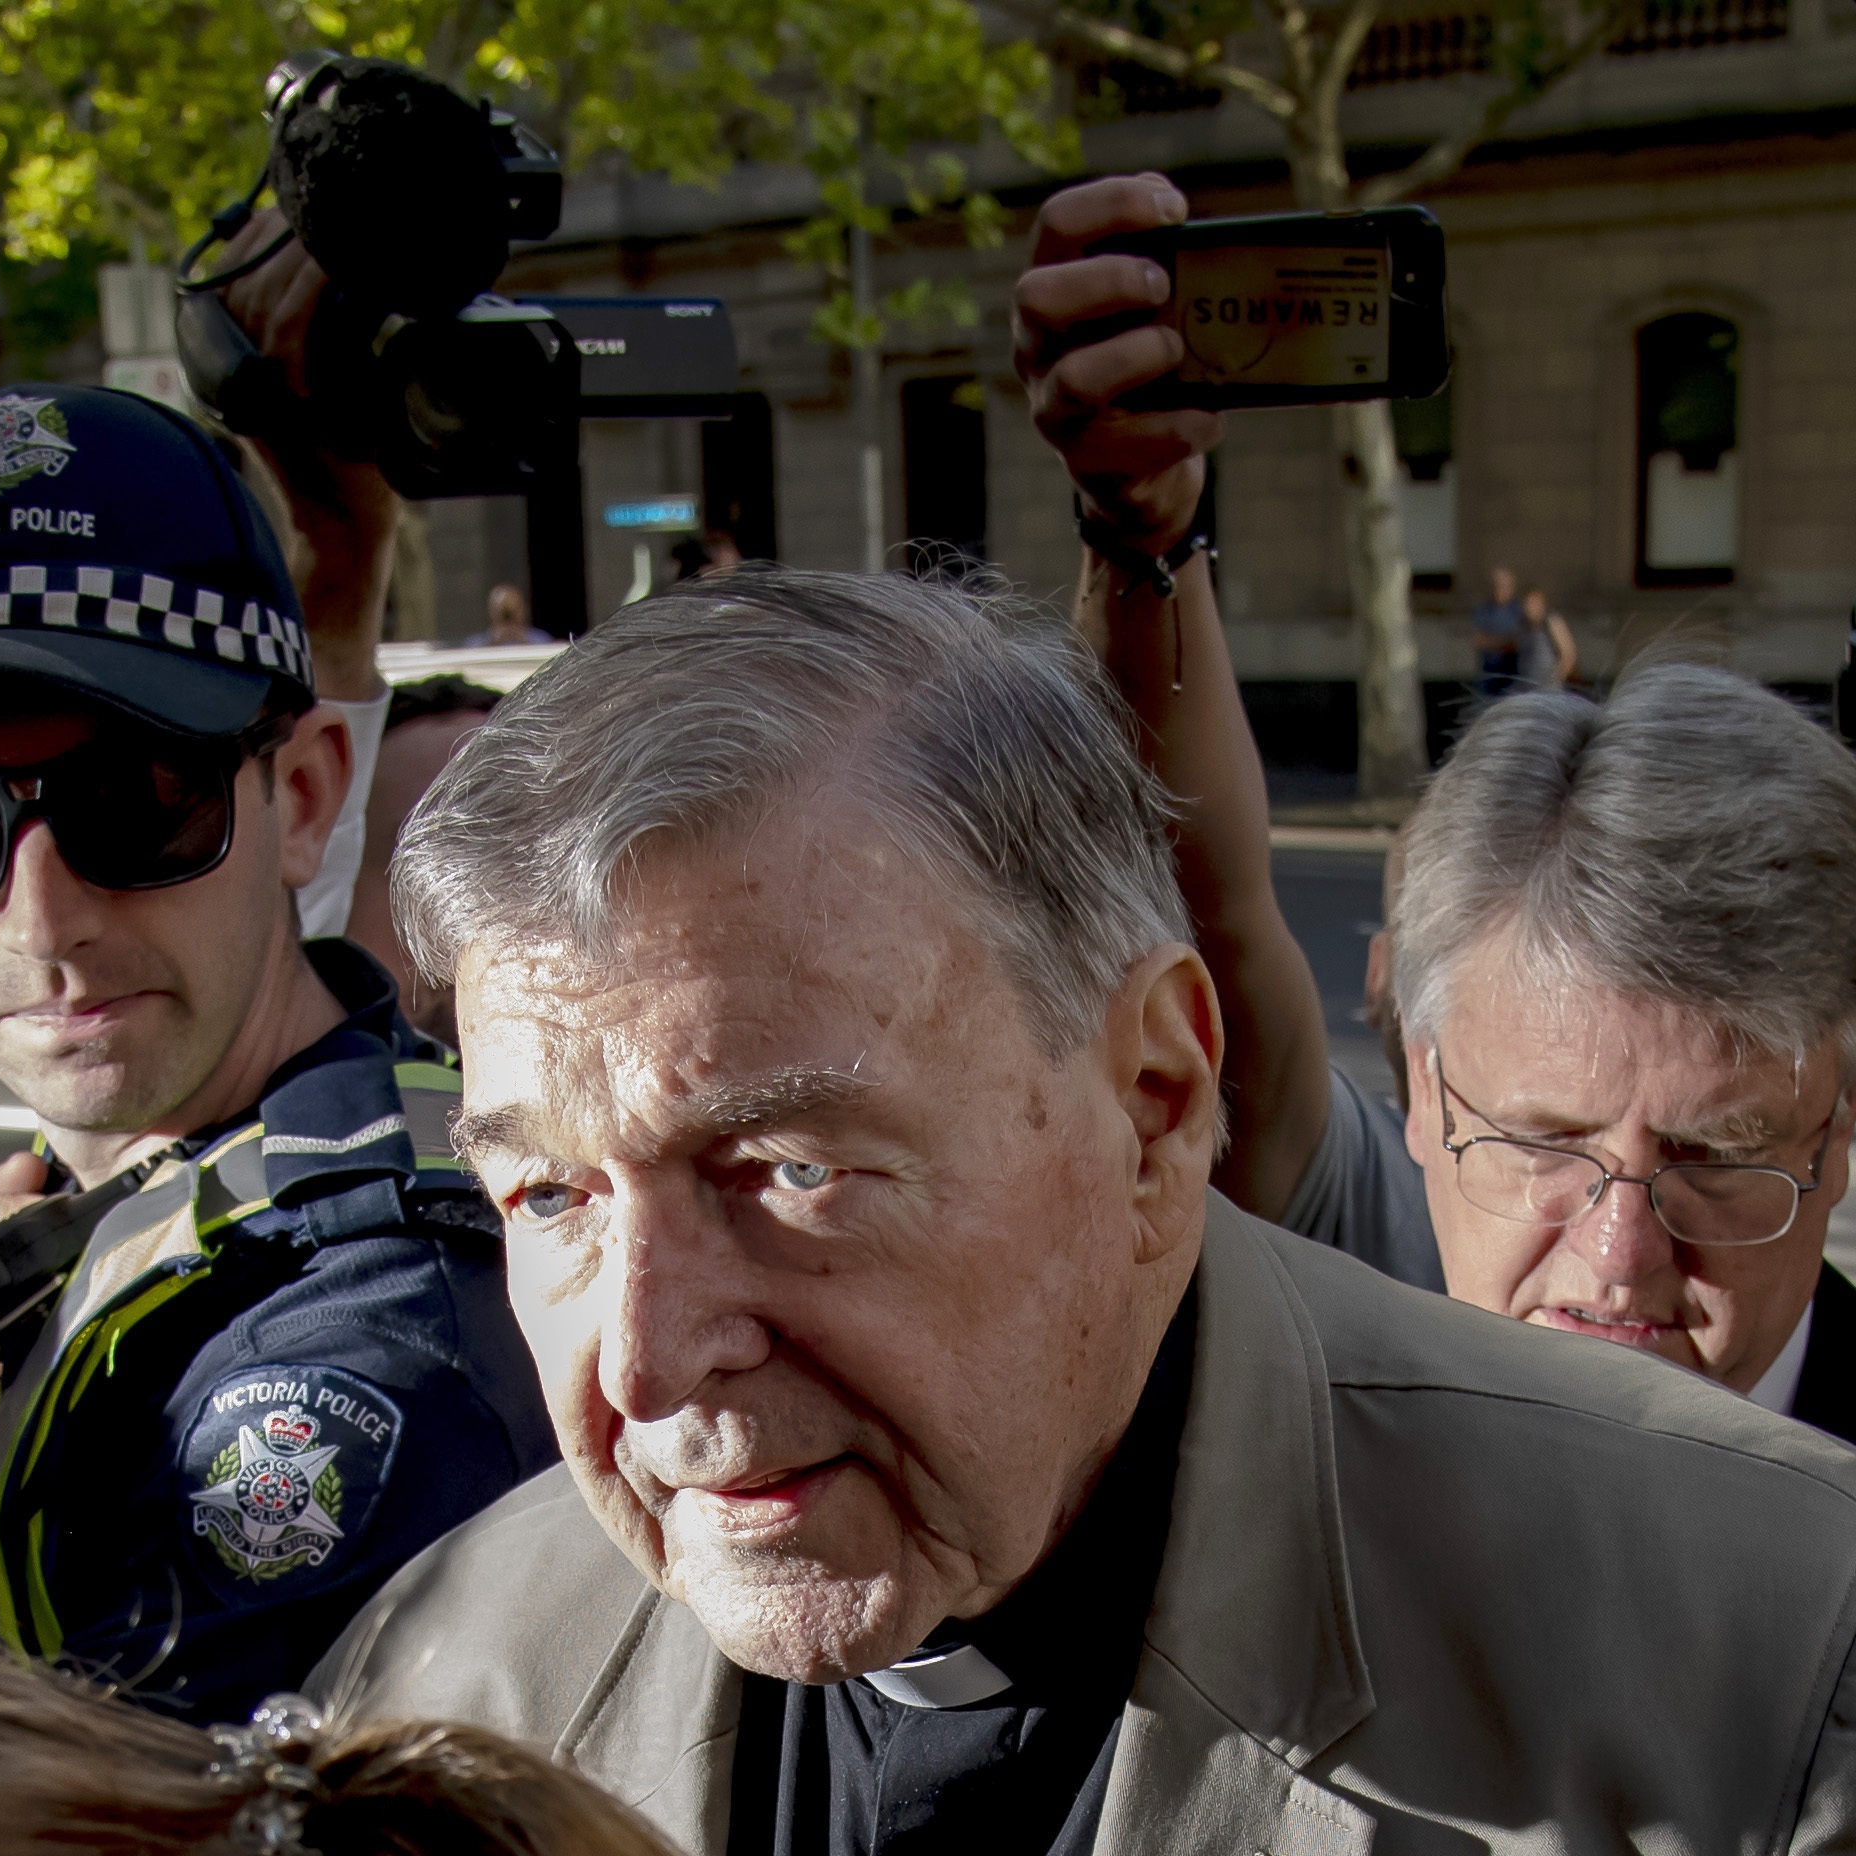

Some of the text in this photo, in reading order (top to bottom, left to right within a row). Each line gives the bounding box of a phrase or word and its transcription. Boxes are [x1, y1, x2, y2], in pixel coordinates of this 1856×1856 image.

[1194, 297, 1378, 325] REWARDS
[10, 507, 96, 538] POLICE
[212, 1381, 391, 1443] VICTORIA POLICE
[239, 1458, 309, 1496] VICTORIA
[239, 1496, 296, 1524] POLICE
[249, 1544, 277, 1558] THE
